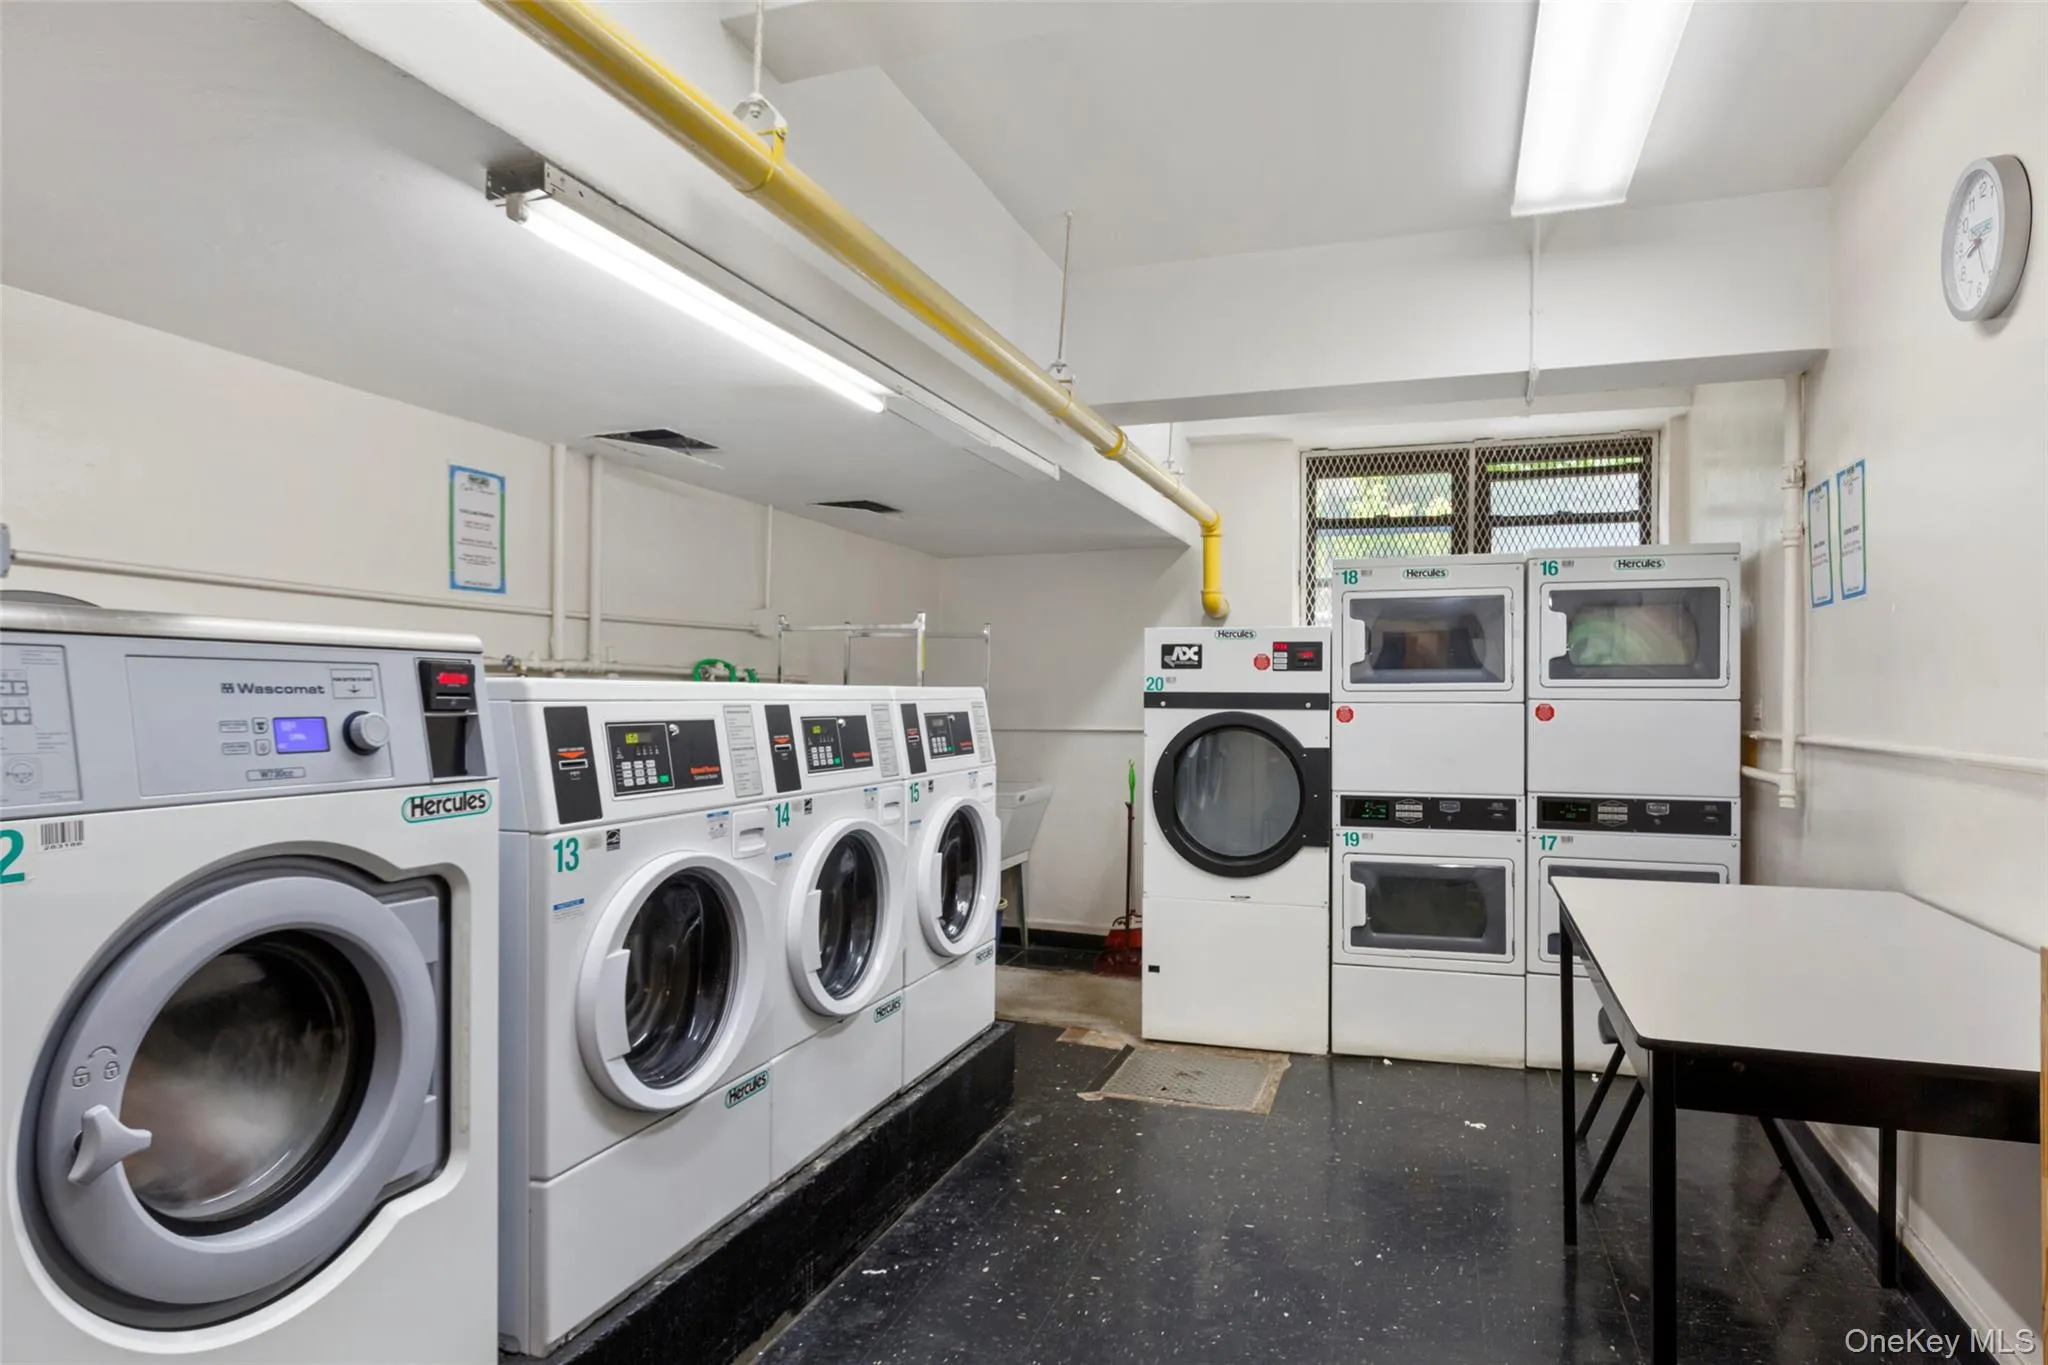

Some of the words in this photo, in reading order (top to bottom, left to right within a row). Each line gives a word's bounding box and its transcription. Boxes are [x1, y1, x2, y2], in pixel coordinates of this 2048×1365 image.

[1540, 560, 1559, 576] 16
[1618, 559, 1662, 569] Hercules
[1341, 570, 1359, 585] 18
[1406, 568, 1446, 578] Hercules
[1217, 630, 1254, 639] Hercules
[237, 683, 325, 695] Wascomat
[1146, 676, 1164, 692] 20
[909, 782, 920, 803] 15
[410, 791, 487, 818] Hercules
[775, 802, 790, 828] 14
[1342, 832, 1360, 847] 19
[1539, 835, 1557, 850] 17
[553, 837, 580, 872] 13
[875, 1000, 902, 1019] Hercules
[727, 1072, 768, 1105] Hercules
